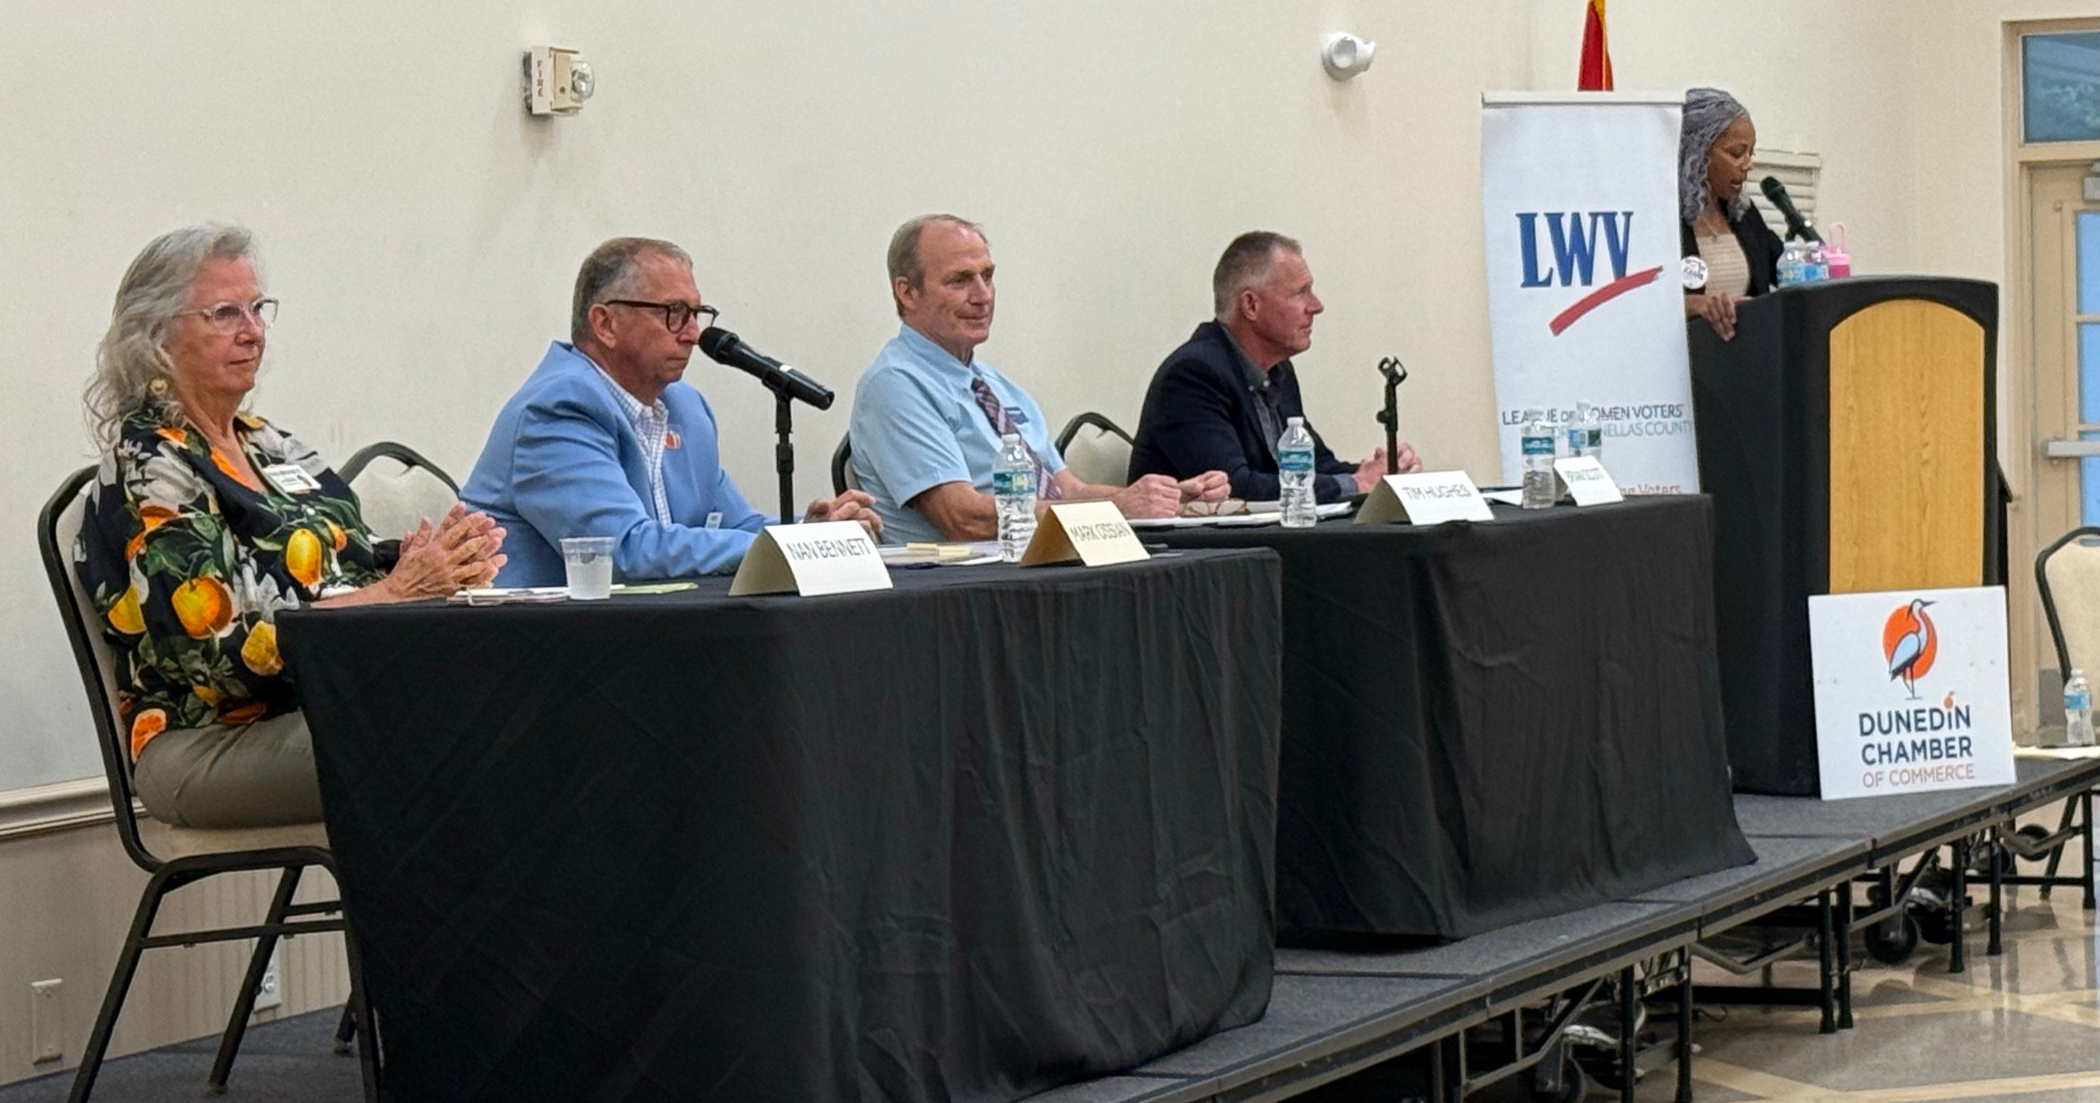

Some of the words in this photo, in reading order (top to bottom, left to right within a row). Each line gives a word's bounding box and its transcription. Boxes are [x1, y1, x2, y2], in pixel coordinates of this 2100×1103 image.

[1515, 211, 1634, 288] LWV
[1502, 408, 1558, 426] LEAE
[1632, 404, 1683, 420] VOTERS
[1069, 524, 1100, 543] MARK
[786, 541, 819, 561] NAN
[816, 538, 872, 560] BENNETT
[1861, 736, 1973, 766] CHAMBER
[1863, 771, 1884, 789] OF
[1889, 763, 1975, 787] COMMERCE
